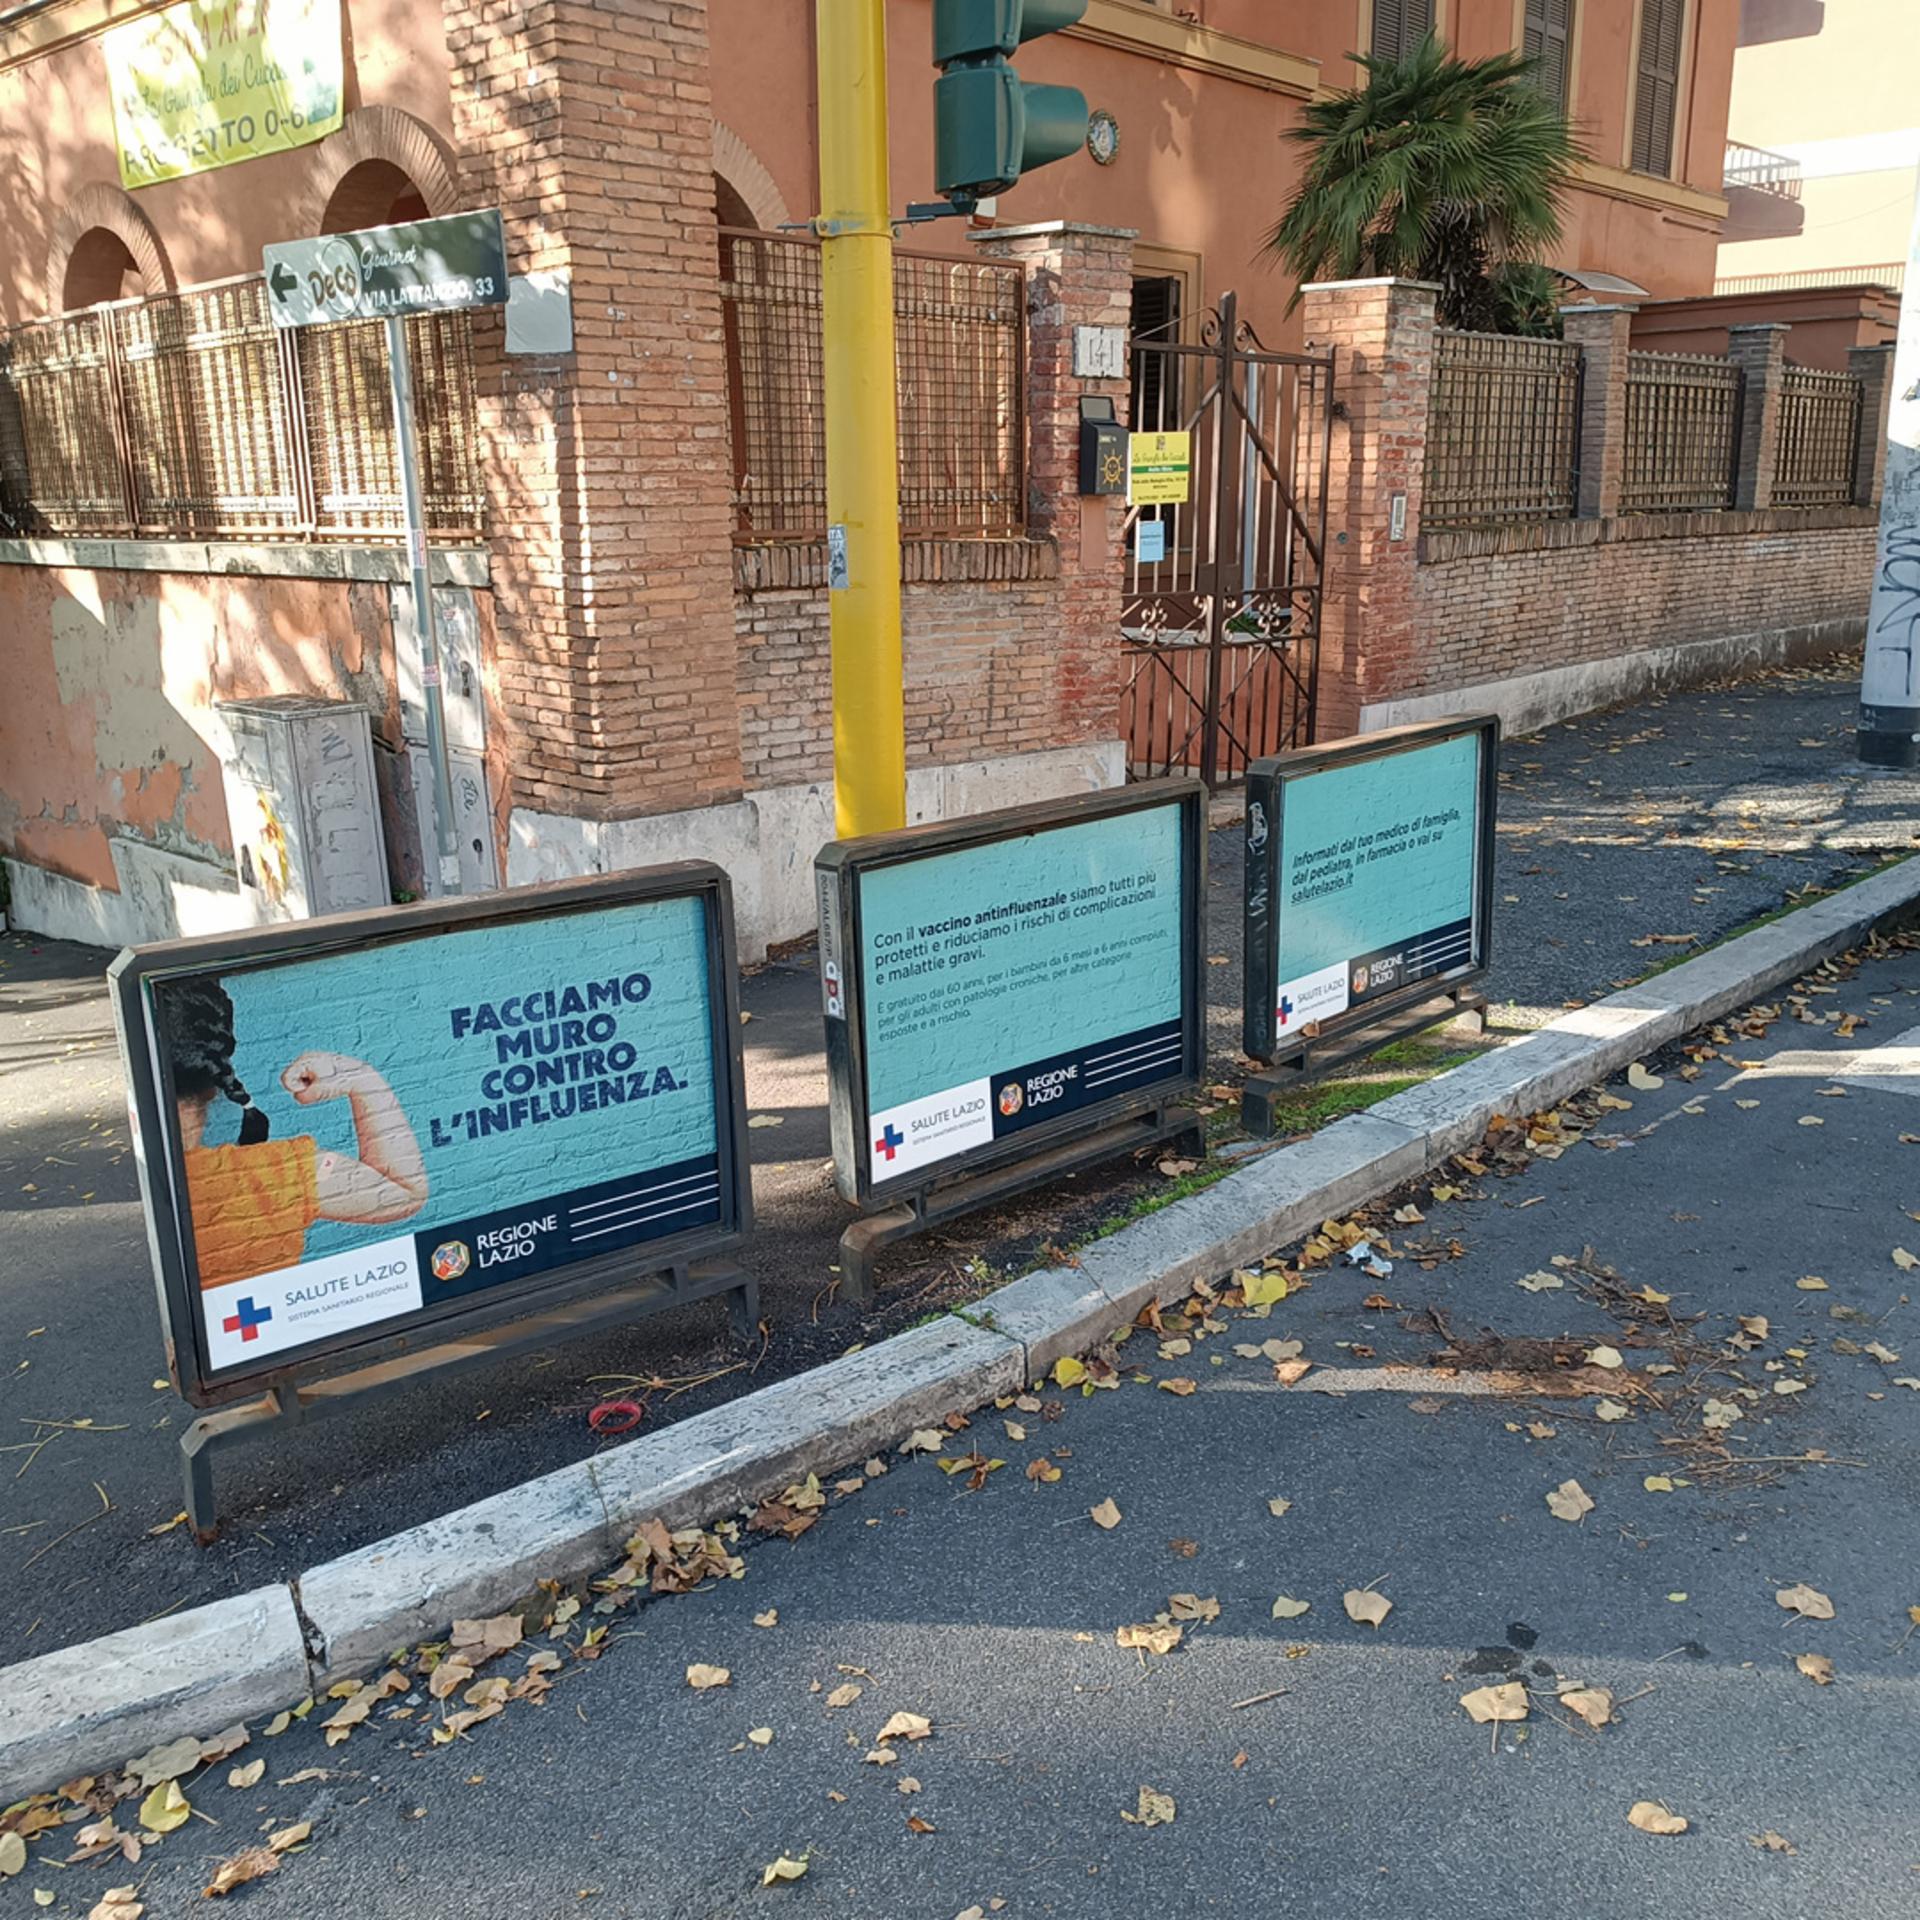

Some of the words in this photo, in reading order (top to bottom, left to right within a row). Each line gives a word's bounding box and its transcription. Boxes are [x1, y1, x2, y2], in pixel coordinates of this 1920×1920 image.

[364, 289, 388, 310] VIA
[475, 276, 495, 297] 33
[1292, 842, 1339, 869] Informati
[1340, 836, 1356, 854] dal
[1358, 834, 1373, 849] tuo
[1375, 821, 1409, 841] medico
[1412, 816, 1421, 832] di
[1422, 808, 1461, 830] famiglia,
[1292, 867, 1309, 886] dal
[1309, 856, 1353, 884] pediatra,
[1355, 852, 1365, 866] in
[1366, 839, 1407, 863] farmacia
[1408, 838, 1416, 849] o
[1417, 830, 1430, 846] vai
[1432, 829, 1443, 842] su
[1291, 872, 1354, 903] salutelazio.it
[874, 931, 903, 949] Con
[906, 926, 915, 941] il
[918, 916, 972, 938] vaccino
[974, 891, 1067, 925] antinfluenzale
[1070, 883, 1107, 902] siamo
[1108, 873, 1135, 893] tutti
[1137, 870, 1157, 888] più
[875, 942, 928, 970] protetti
[932, 941, 941, 952] e
[944, 924, 1011, 950] riduciamo
[1021, 910, 1055, 931] rischi
[1058, 908, 1070, 922] di
[1073, 886, 1156, 918] complicazioni
[876, 974, 885, 985] e
[888, 956, 945, 982] malattie
[948, 945, 986, 969] gravi.
[886, 992, 927, 1012] gratuito
[929, 986, 945, 1000] dai
[947, 982, 960, 995] 60
[987, 971, 1004, 985] per
[1010, 958, 1048, 978] bambini
[1049, 955, 1061, 968] da
[1063, 952, 1069, 964] 6
[1071, 946, 1092, 961] mesi
[1101, 942, 1108, 953] 6
[1109, 938, 1128, 952] anni
[1370, 952, 1404, 974] REGIONE
[1370, 969, 1394, 987] LAZIO
[450, 972, 651, 1039] FACCIAMO
[878, 1014, 895, 1030] per
[897, 1009, 910, 1025] gli
[913, 1002, 940, 1018] adulti
[943, 998, 961, 1009] con
[963, 984, 1007, 1006] patologie
[1052, 968, 1068, 981] per
[1070, 962, 1089, 975] altre
[1091, 951, 1132, 969] categorie
[495, 1012, 617, 1064] MURO
[879, 1021, 918, 1042] esposte
[481, 1041, 637, 1100] CONTRO
[1027, 1064, 1079, 1092] REGIONE
[430, 1065, 688, 1148] L'INFLUENZA.
[911, 1110, 951, 1133] SALUTE
[952, 1097, 986, 1118] LAZIO
[1027, 1084, 1064, 1107] LAZIO
[476, 1214, 558, 1251] REGIONE
[478, 1239, 536, 1269] LAZIO
[284, 1276, 349, 1306] SALUTE
[354, 1260, 408, 1287] LAZIO
[287, 1305, 321, 1323] SISTEMA
[321, 1295, 365, 1313] SANITARIO
[365, 1280, 410, 1300] REGIONALE
